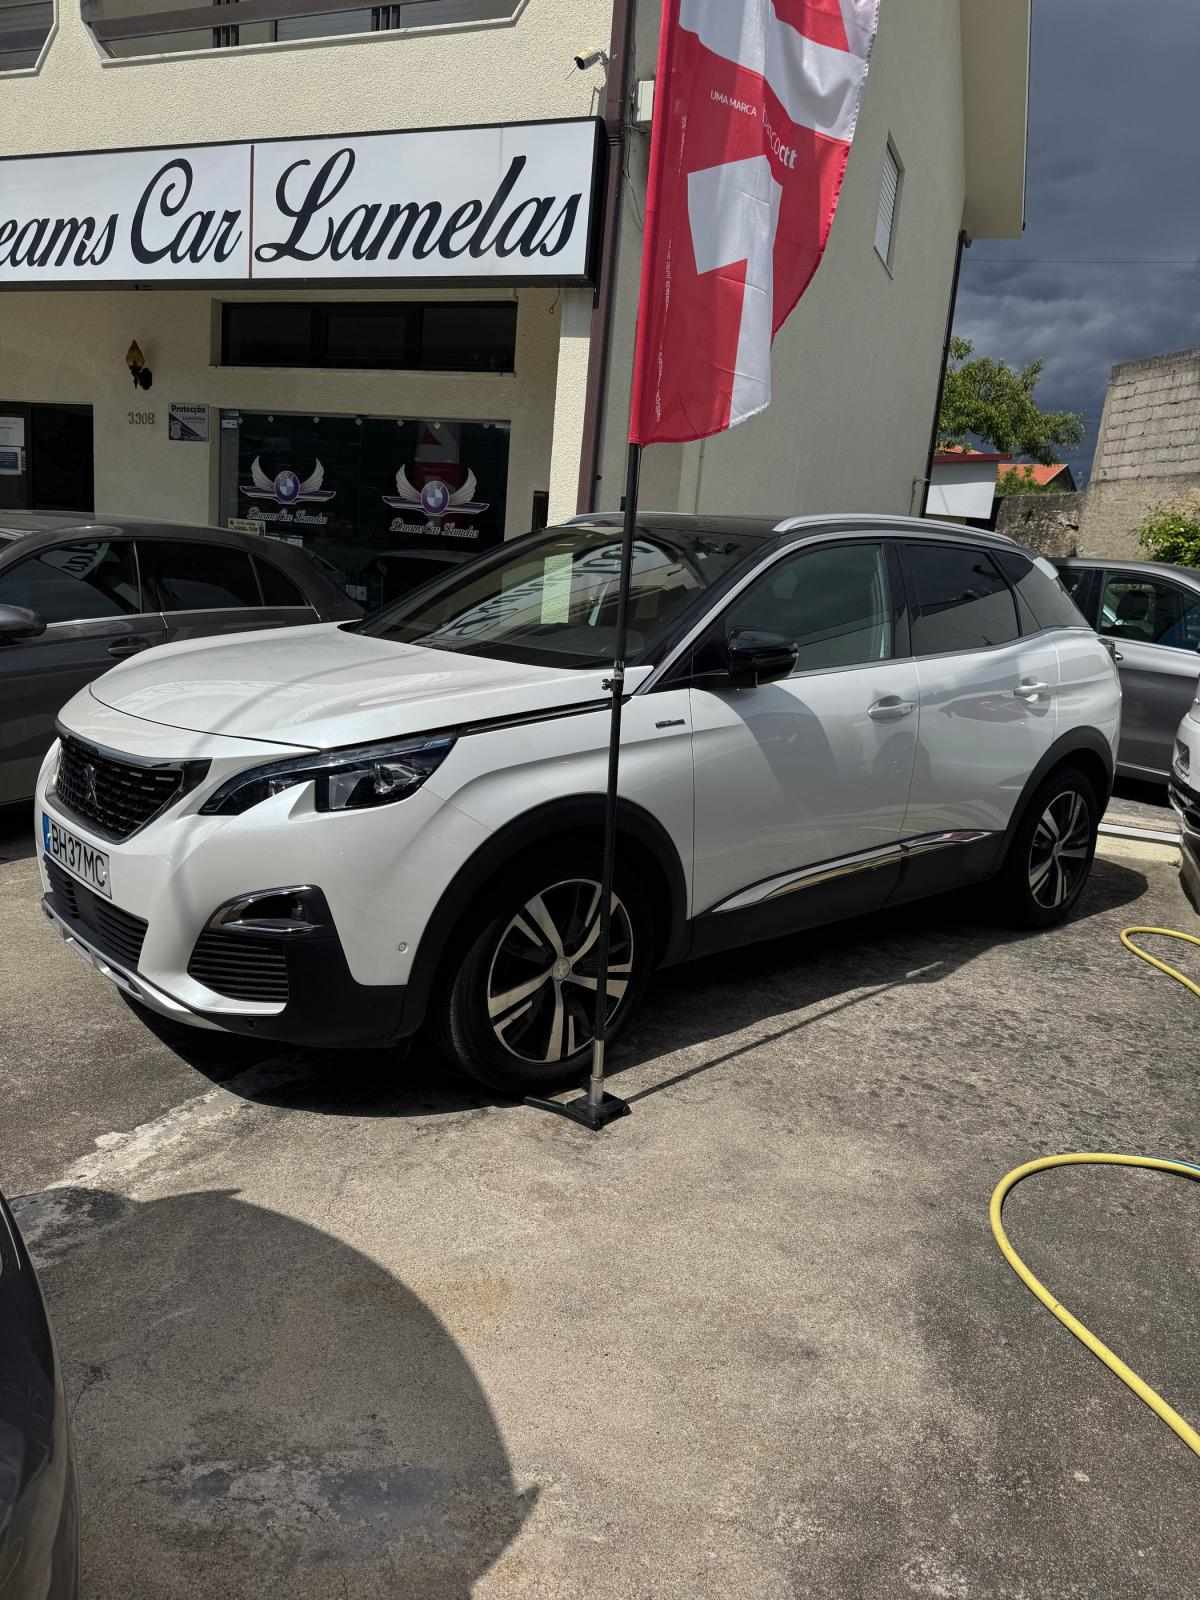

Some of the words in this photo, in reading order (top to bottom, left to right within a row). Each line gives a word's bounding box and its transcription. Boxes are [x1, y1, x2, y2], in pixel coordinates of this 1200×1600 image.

[709, 89, 729, 105] UMA
[729, 98, 758, 117] MARCA
[131, 158, 242, 265] Car
[255, 147, 582, 263] Lamelas
